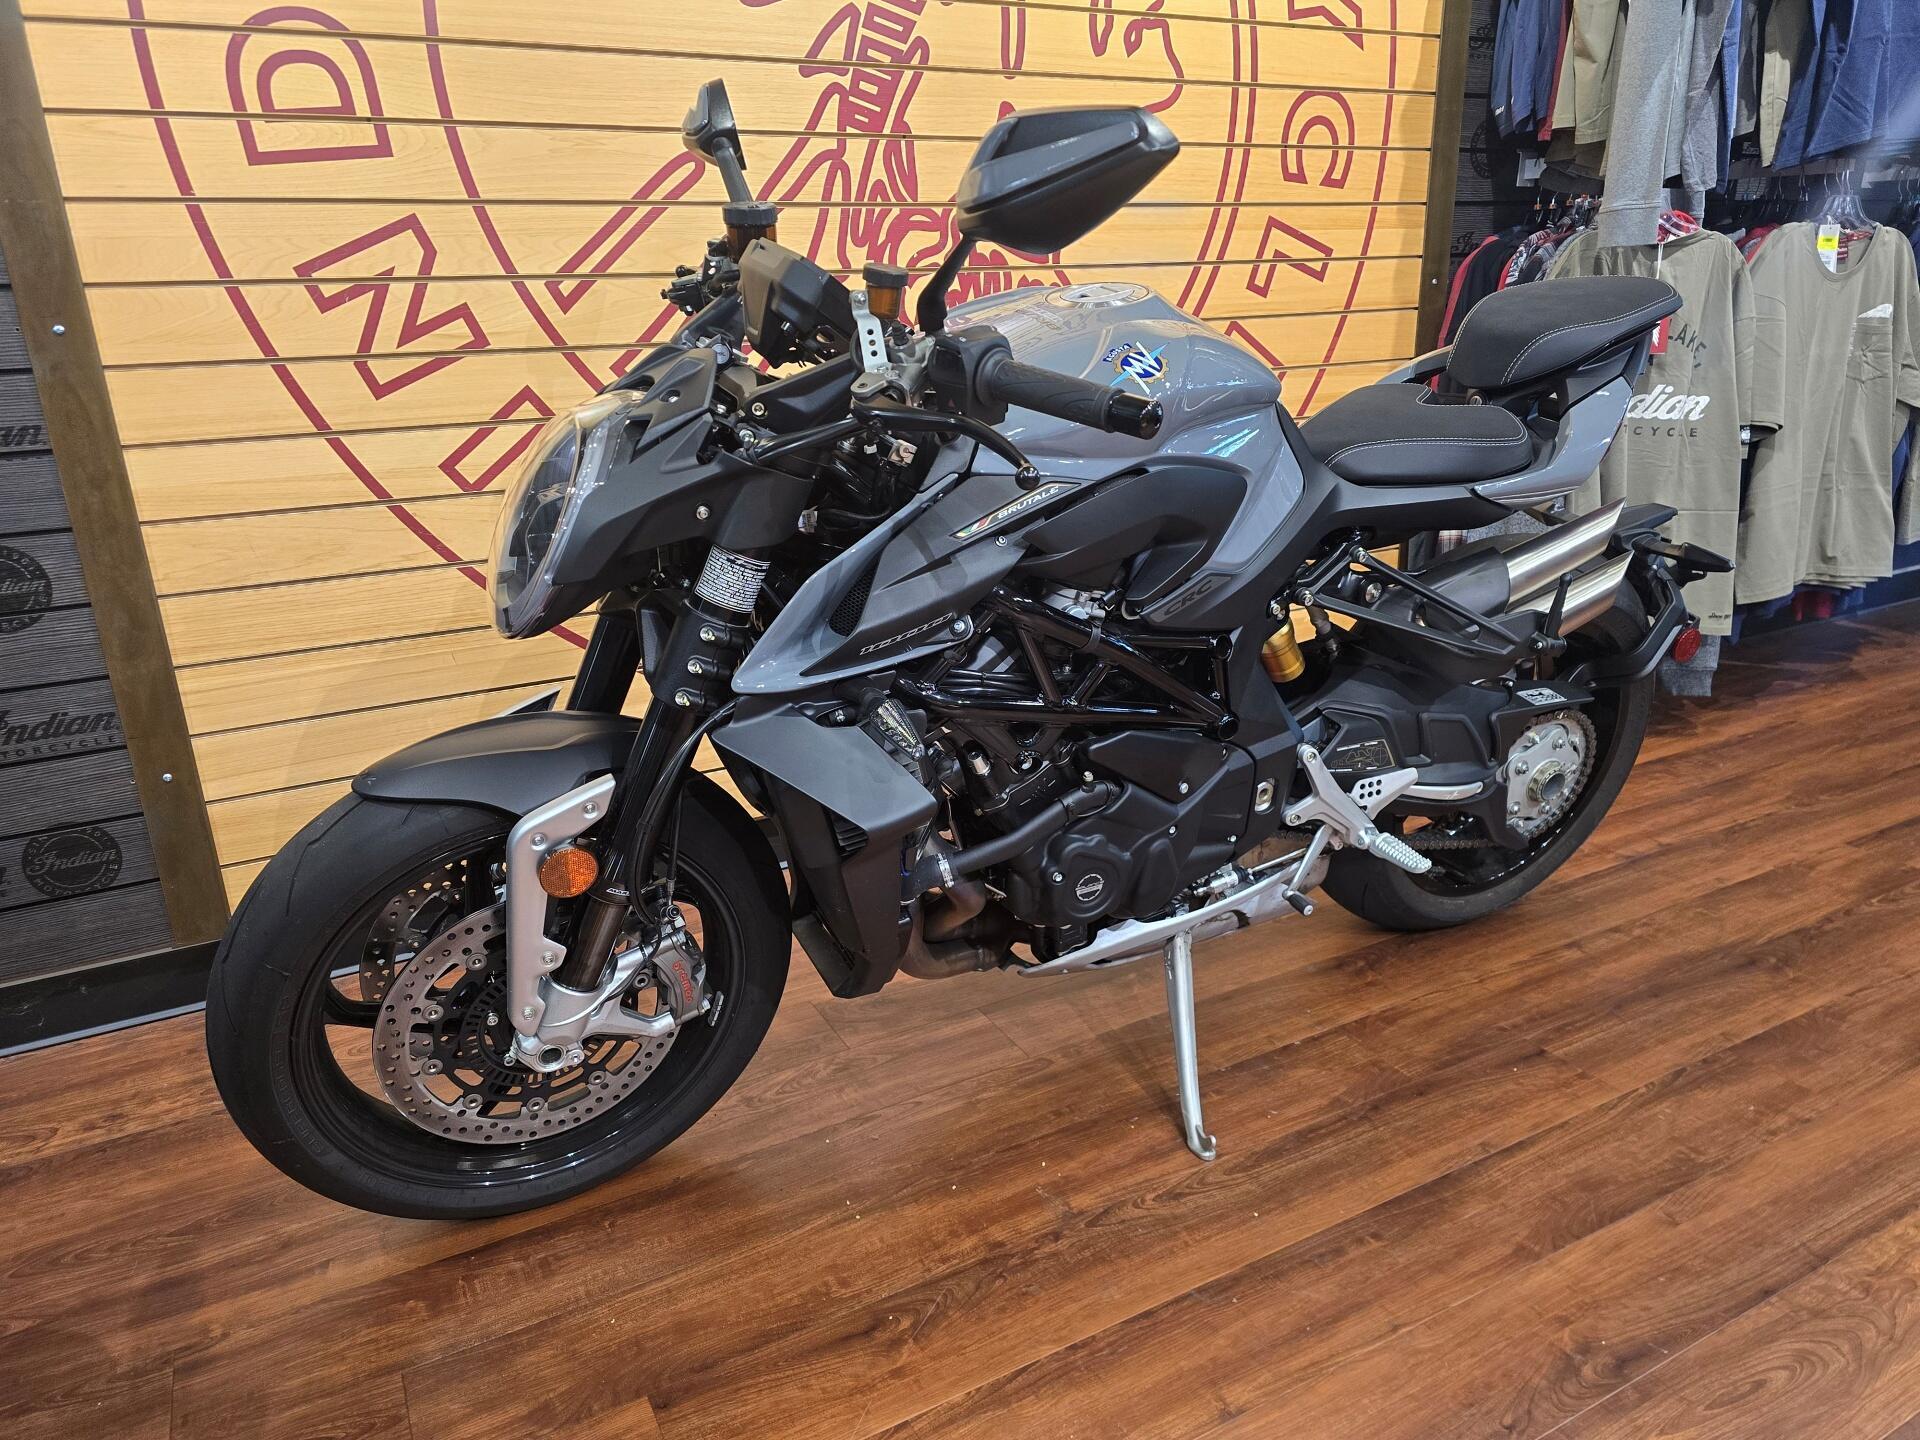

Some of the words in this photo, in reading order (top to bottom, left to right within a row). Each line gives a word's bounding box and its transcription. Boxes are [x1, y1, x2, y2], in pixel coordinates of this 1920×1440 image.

[1627, 384, 1711, 420] dian
[997, 484, 1060, 519] BRUTALE
[26, 848, 118, 875] Indian
[672, 960, 693, 1004] brembo
